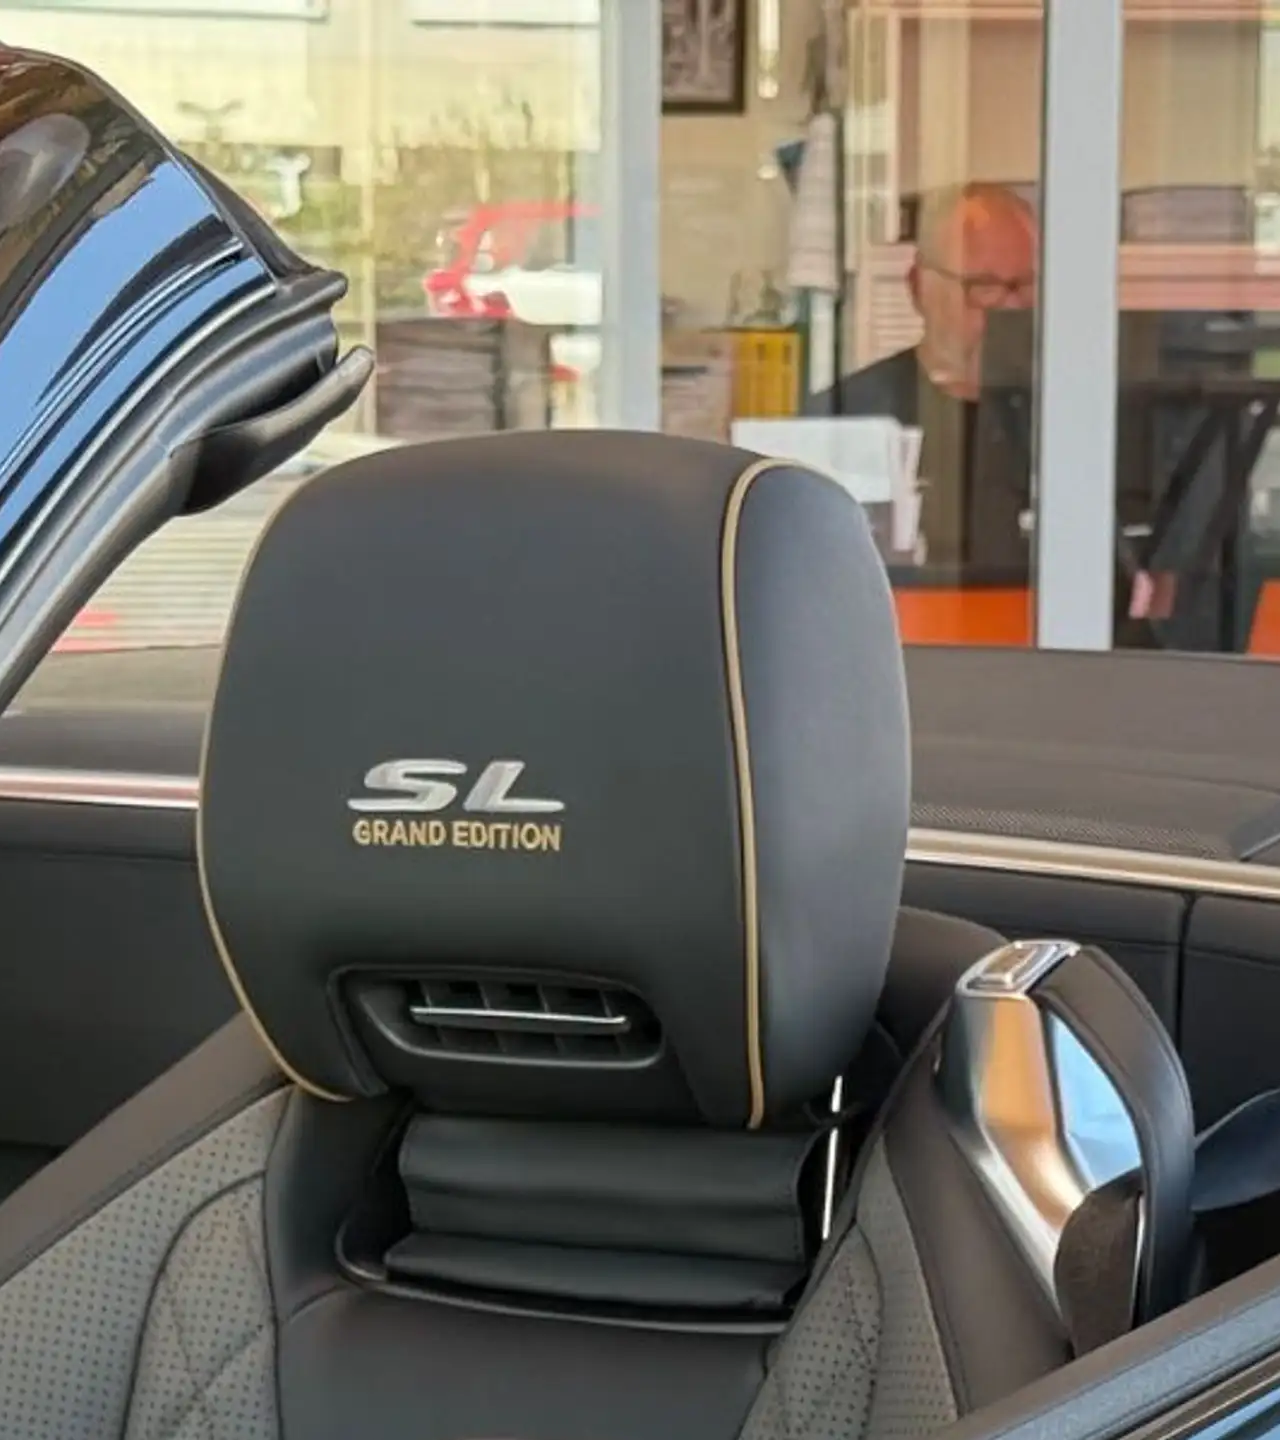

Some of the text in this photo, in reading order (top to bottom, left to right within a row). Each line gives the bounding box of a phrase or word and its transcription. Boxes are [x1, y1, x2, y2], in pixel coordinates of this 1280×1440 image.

[347, 758, 565, 812] SL
[352, 819, 562, 851] GRAND EDITION
